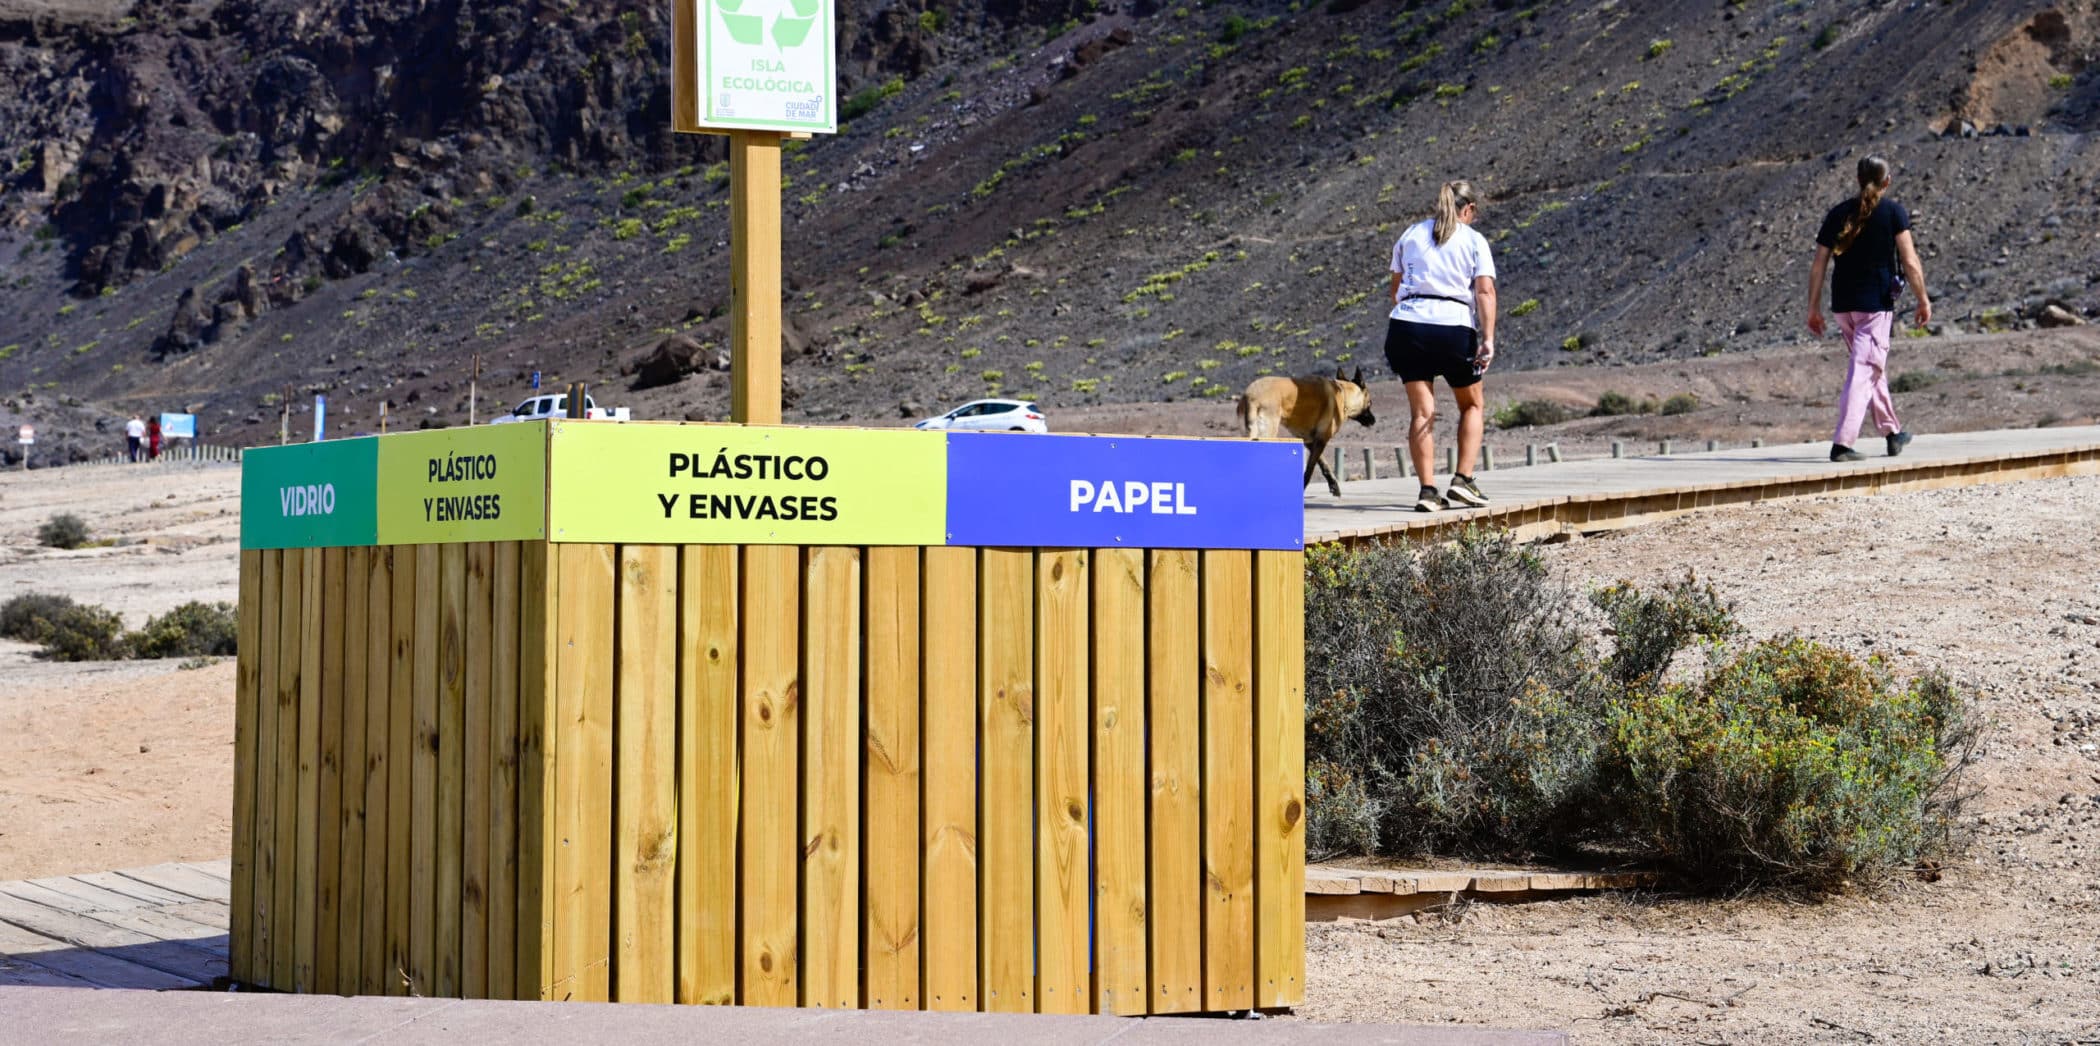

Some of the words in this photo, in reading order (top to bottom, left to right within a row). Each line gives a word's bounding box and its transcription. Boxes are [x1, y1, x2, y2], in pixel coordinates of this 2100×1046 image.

[751, 58, 785, 73] ISLA
[722, 76, 814, 93] ECOLÓGICA
[785, 101, 816, 110] CIUDAD
[785, 109, 798, 117] DE
[798, 110, 817, 118] MAR
[428, 450, 497, 483] PLÁSTICO
[669, 446, 829, 482] PLÁSTICO
[279, 482, 336, 517] VIDRIO
[424, 498, 434, 522] Y
[435, 494, 501, 522] ENVASES
[657, 493, 679, 518] Y
[689, 494, 838, 522] ENVASES
[1069, 479, 1197, 515] PAPEL
